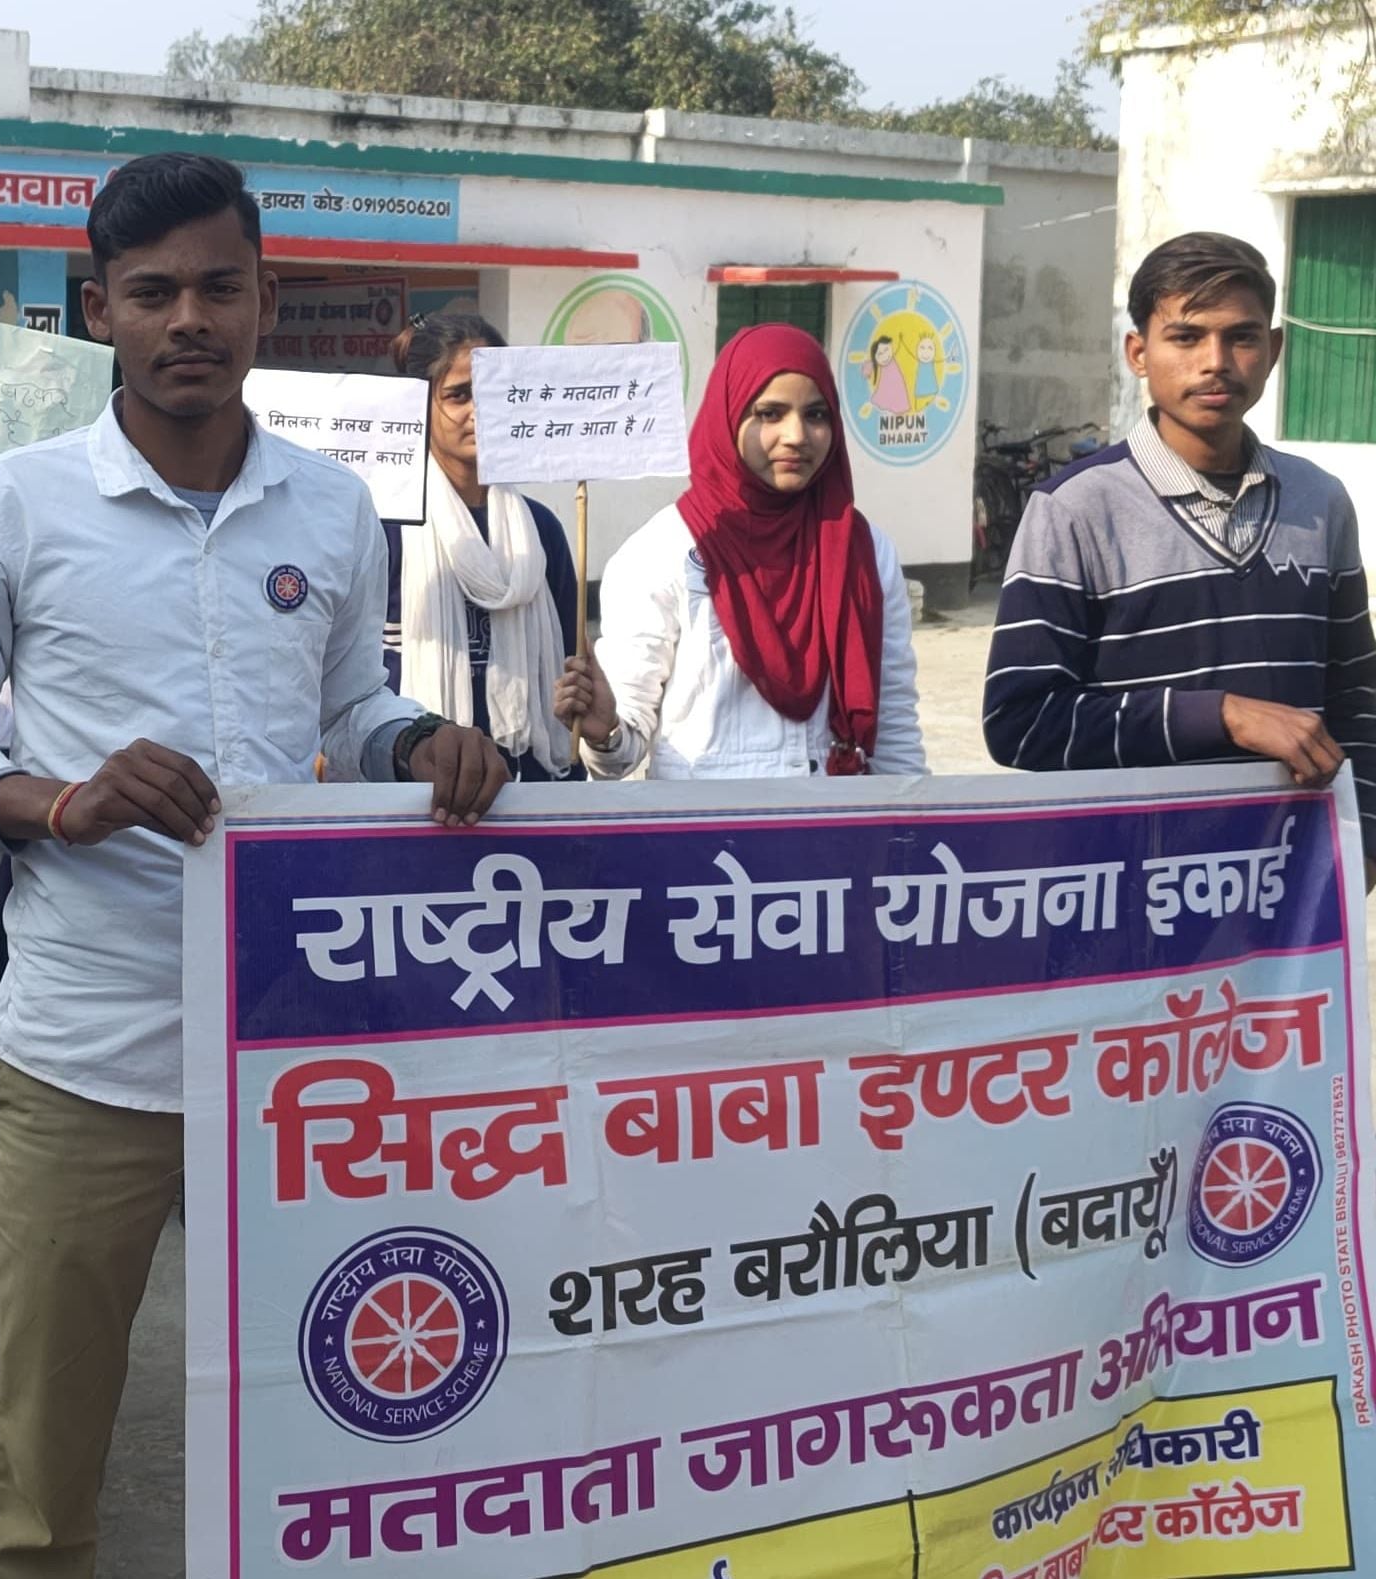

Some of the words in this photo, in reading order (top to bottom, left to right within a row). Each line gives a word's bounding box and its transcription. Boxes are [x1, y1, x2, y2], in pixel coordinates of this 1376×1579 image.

[268, 410, 322, 431] मिलकर
[330, 417, 373, 433] अलख
[381, 418, 424, 436] जगाये
[507, 384, 533, 405] देश
[540, 383, 556, 402] के
[562, 384, 620, 403] मतदाता
[627, 378, 639, 401] है
[879, 415, 925, 431] NIPUN
[510, 420, 538, 439] वोट
[544, 419, 574, 439] देना
[579, 420, 618, 437] आता
[624, 414, 637, 436] है
[879, 432, 929, 445] BHARAT
[293, 853, 642, 1012] राष्ट्रीय
[668, 850, 852, 965] सेवा
[873, 842, 1125, 946] योजना
[1143, 816, 1297, 937] इकाई
[263, 1058, 569, 1202] सिद्ध
[597, 1060, 825, 1164] बाबा
[850, 1034, 1078, 1151] इण्टर
[1094, 978, 1329, 1103] कॉलेज
[1231, 1232, 1274, 1254] SERVICE
[1275, 1186, 1306, 1233] SCHEME
[1336, 1162, 1348, 1222] BISAULI
[321, 1258, 376, 1321] राष्ट्रीय
[380, 1243, 425, 1268] सेवा
[434, 1246, 485, 1305] योजना
[548, 1247, 712, 1337] शरह
[730, 1193, 993, 1301] बरौलिया
[1336, 1225, 1351, 1275] STATE
[1342, 1280, 1359, 1337] PHOTO
[324, 1356, 380, 1421] NATIONAL
[384, 1396, 447, 1425] SERVICE
[446, 1342, 489, 1403] SCHEME
[1350, 1344, 1370, 1425] PRAKASH
[278, 1437, 662, 1560] मतदाता
[681, 1350, 1083, 1491] जागरूकता
[992, 1470, 1102, 1540] कार्यक्रम
[1154, 1481, 1301, 1537] कॉलेज
